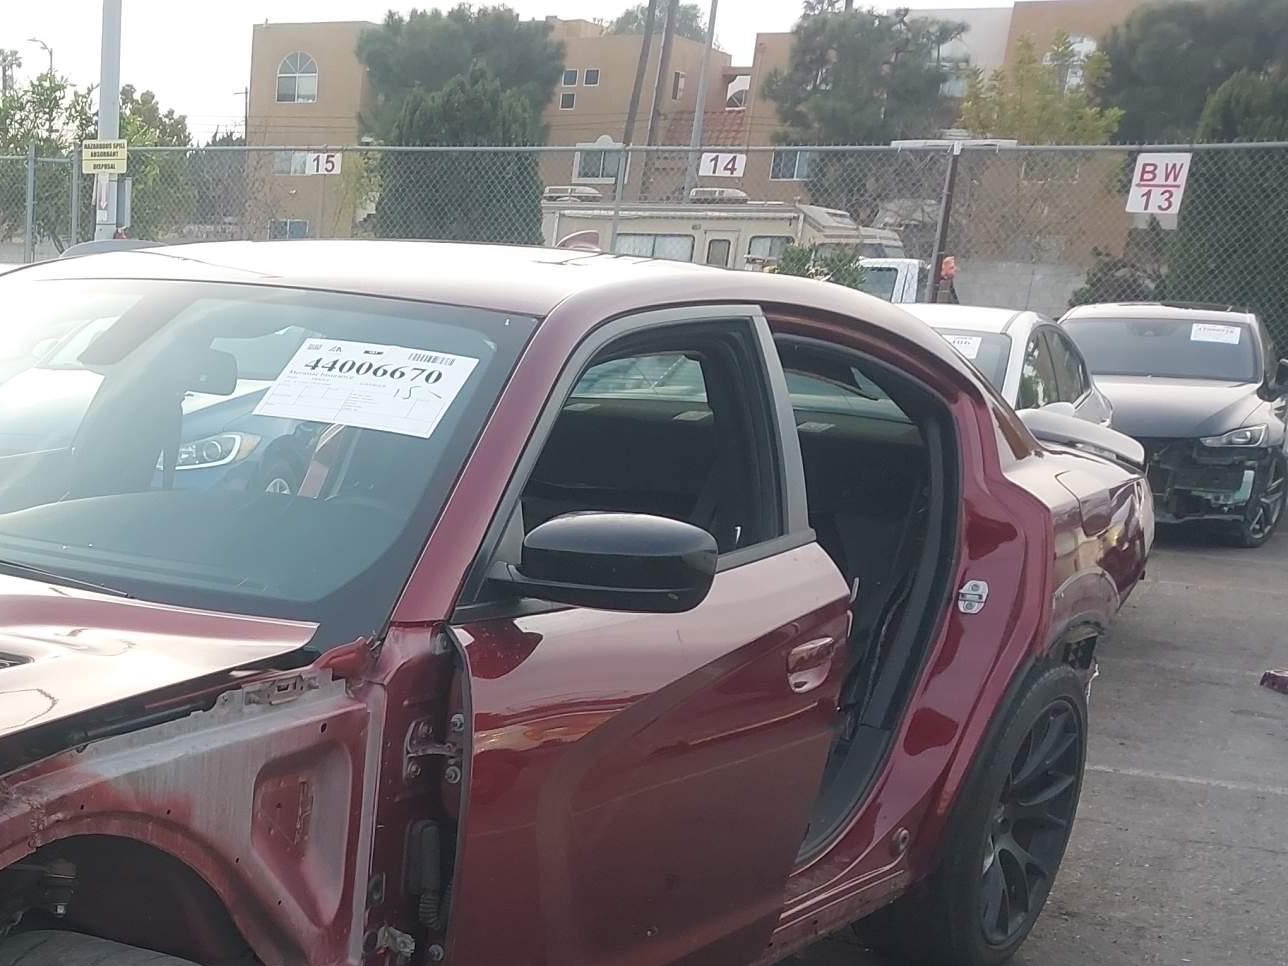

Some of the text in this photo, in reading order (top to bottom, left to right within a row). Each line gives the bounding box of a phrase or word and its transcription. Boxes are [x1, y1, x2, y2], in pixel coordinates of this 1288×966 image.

[313, 154, 335, 173] 15
[709, 154, 738, 176] 14
[1140, 188, 1174, 211] 13
[304, 357, 443, 384] 44006670
